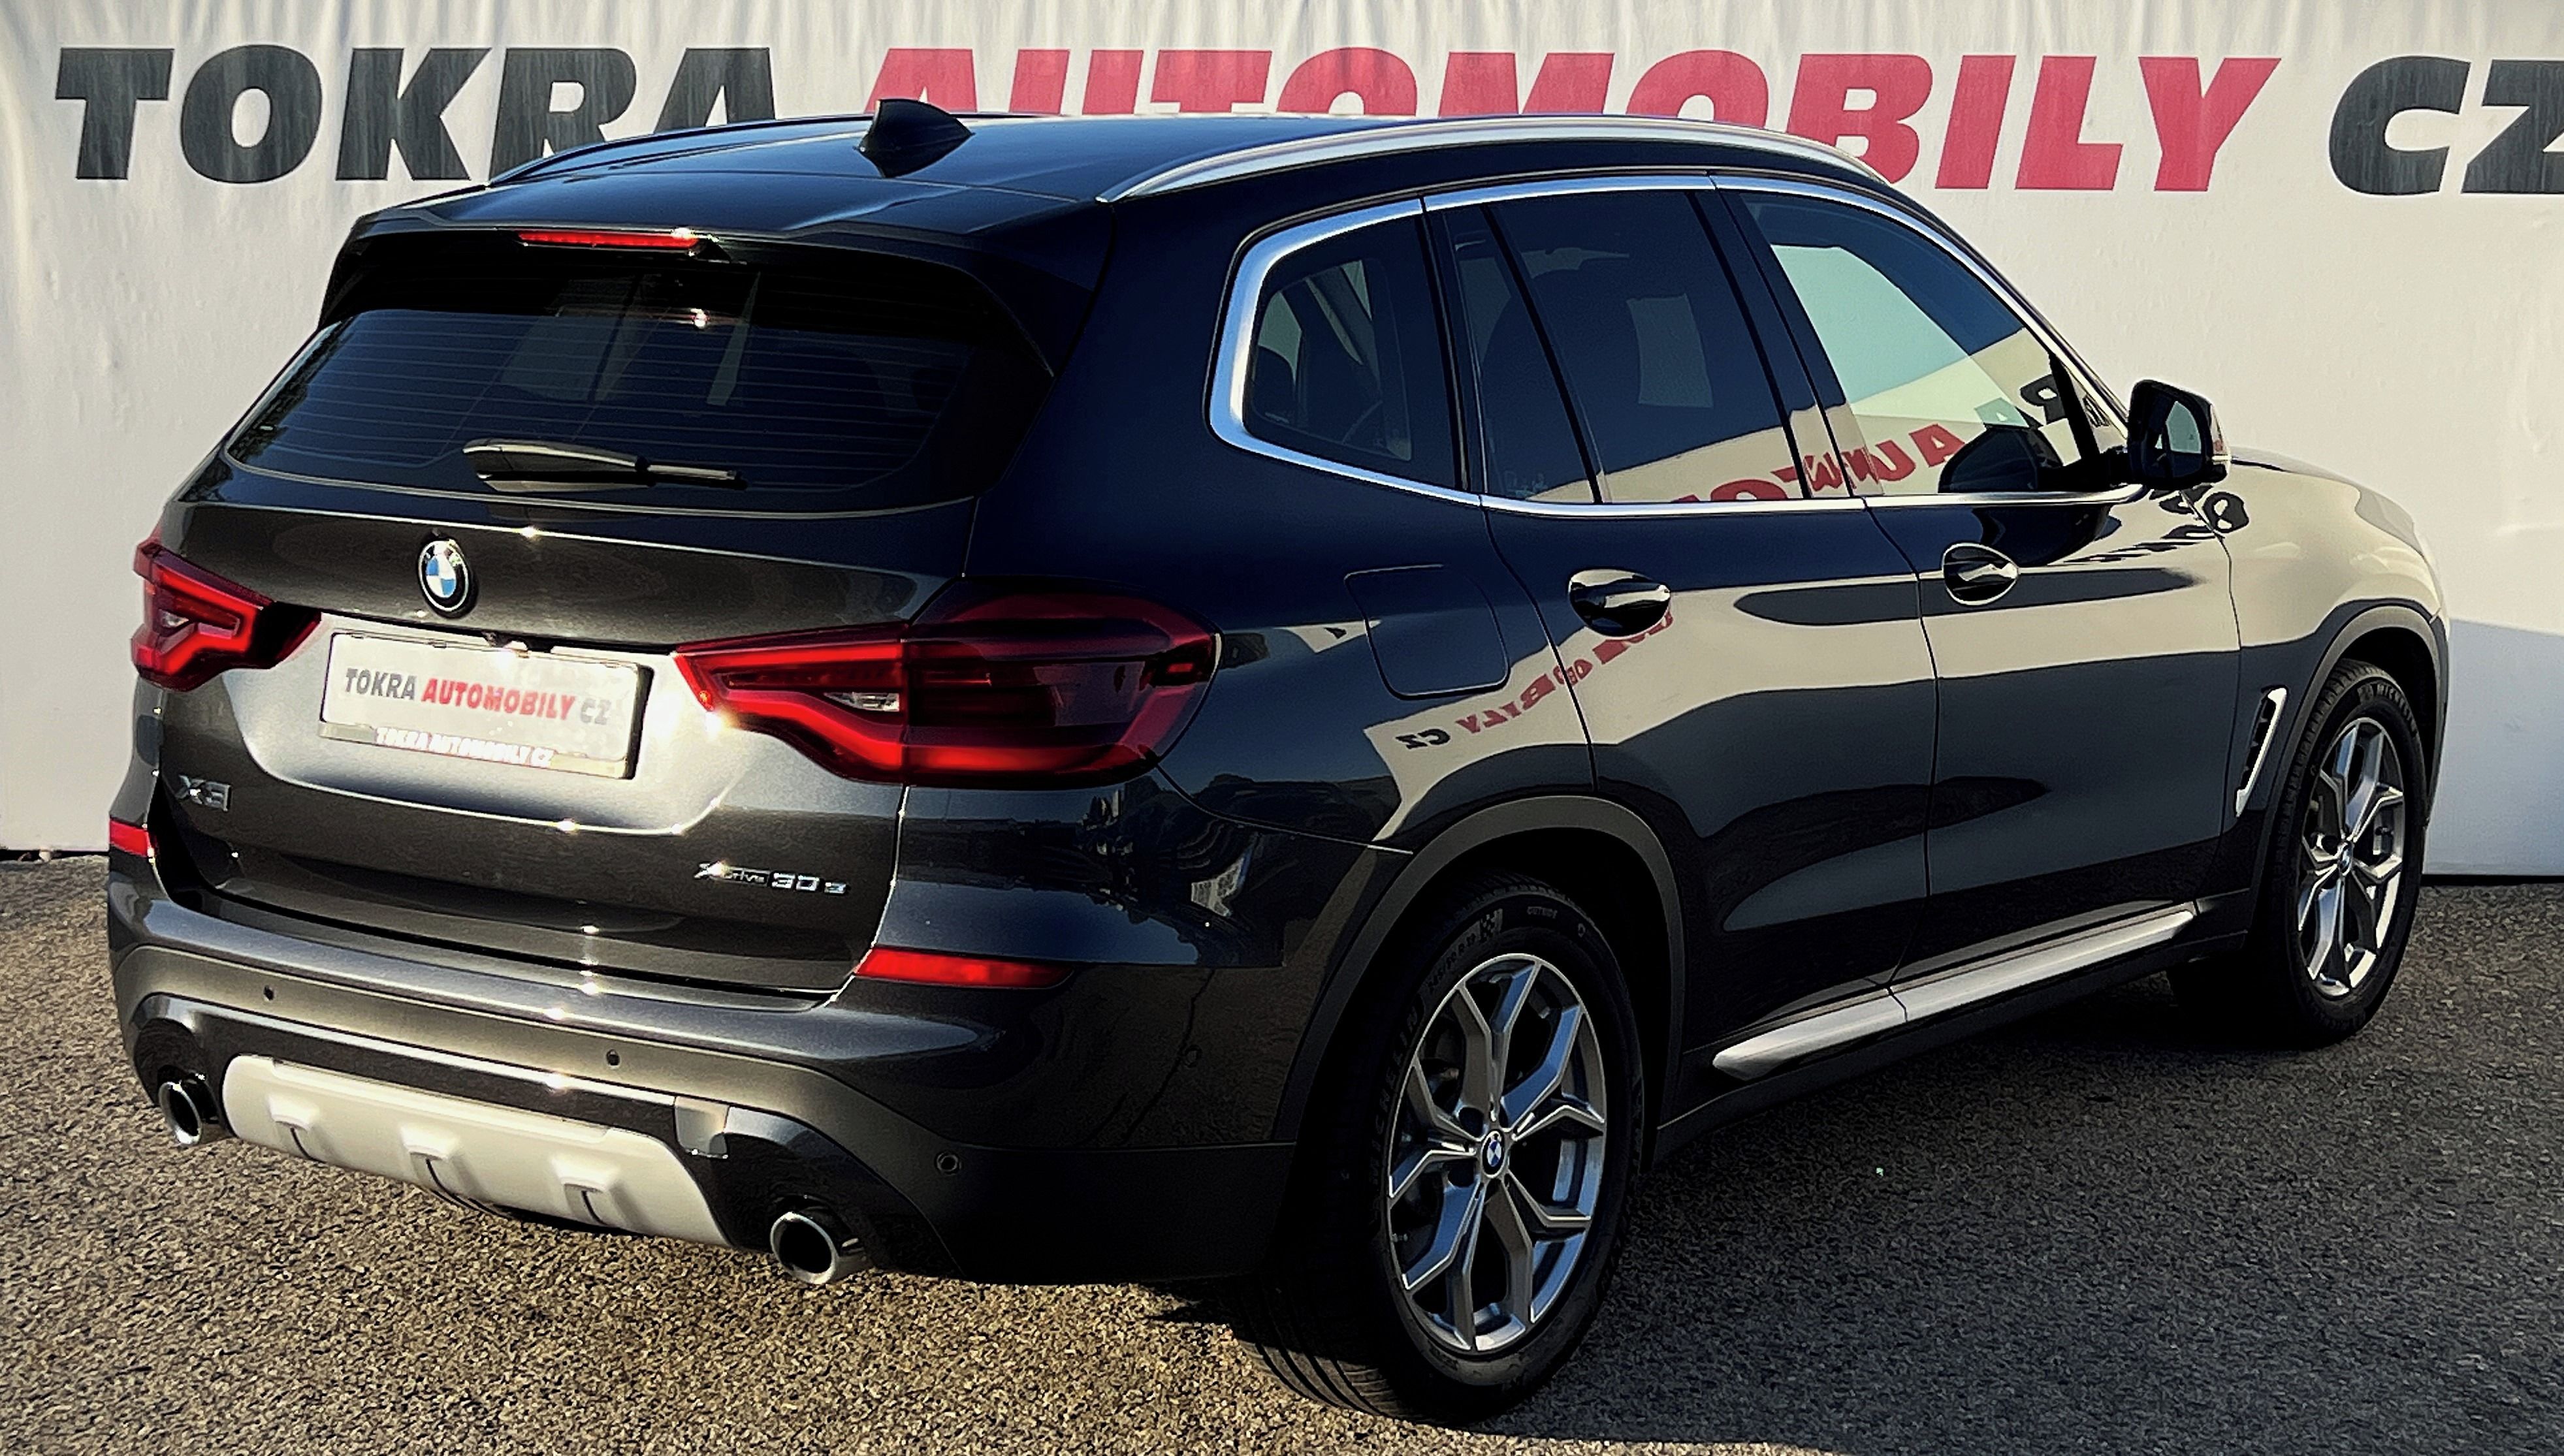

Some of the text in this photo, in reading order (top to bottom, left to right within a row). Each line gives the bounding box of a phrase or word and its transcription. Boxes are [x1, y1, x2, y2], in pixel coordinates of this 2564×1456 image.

[56, 44, 776, 183] TOKRA
[2328, 55, 2564, 196] CZ
[345, 668, 612, 725] TOKRA AUTOMOBILY CZ
